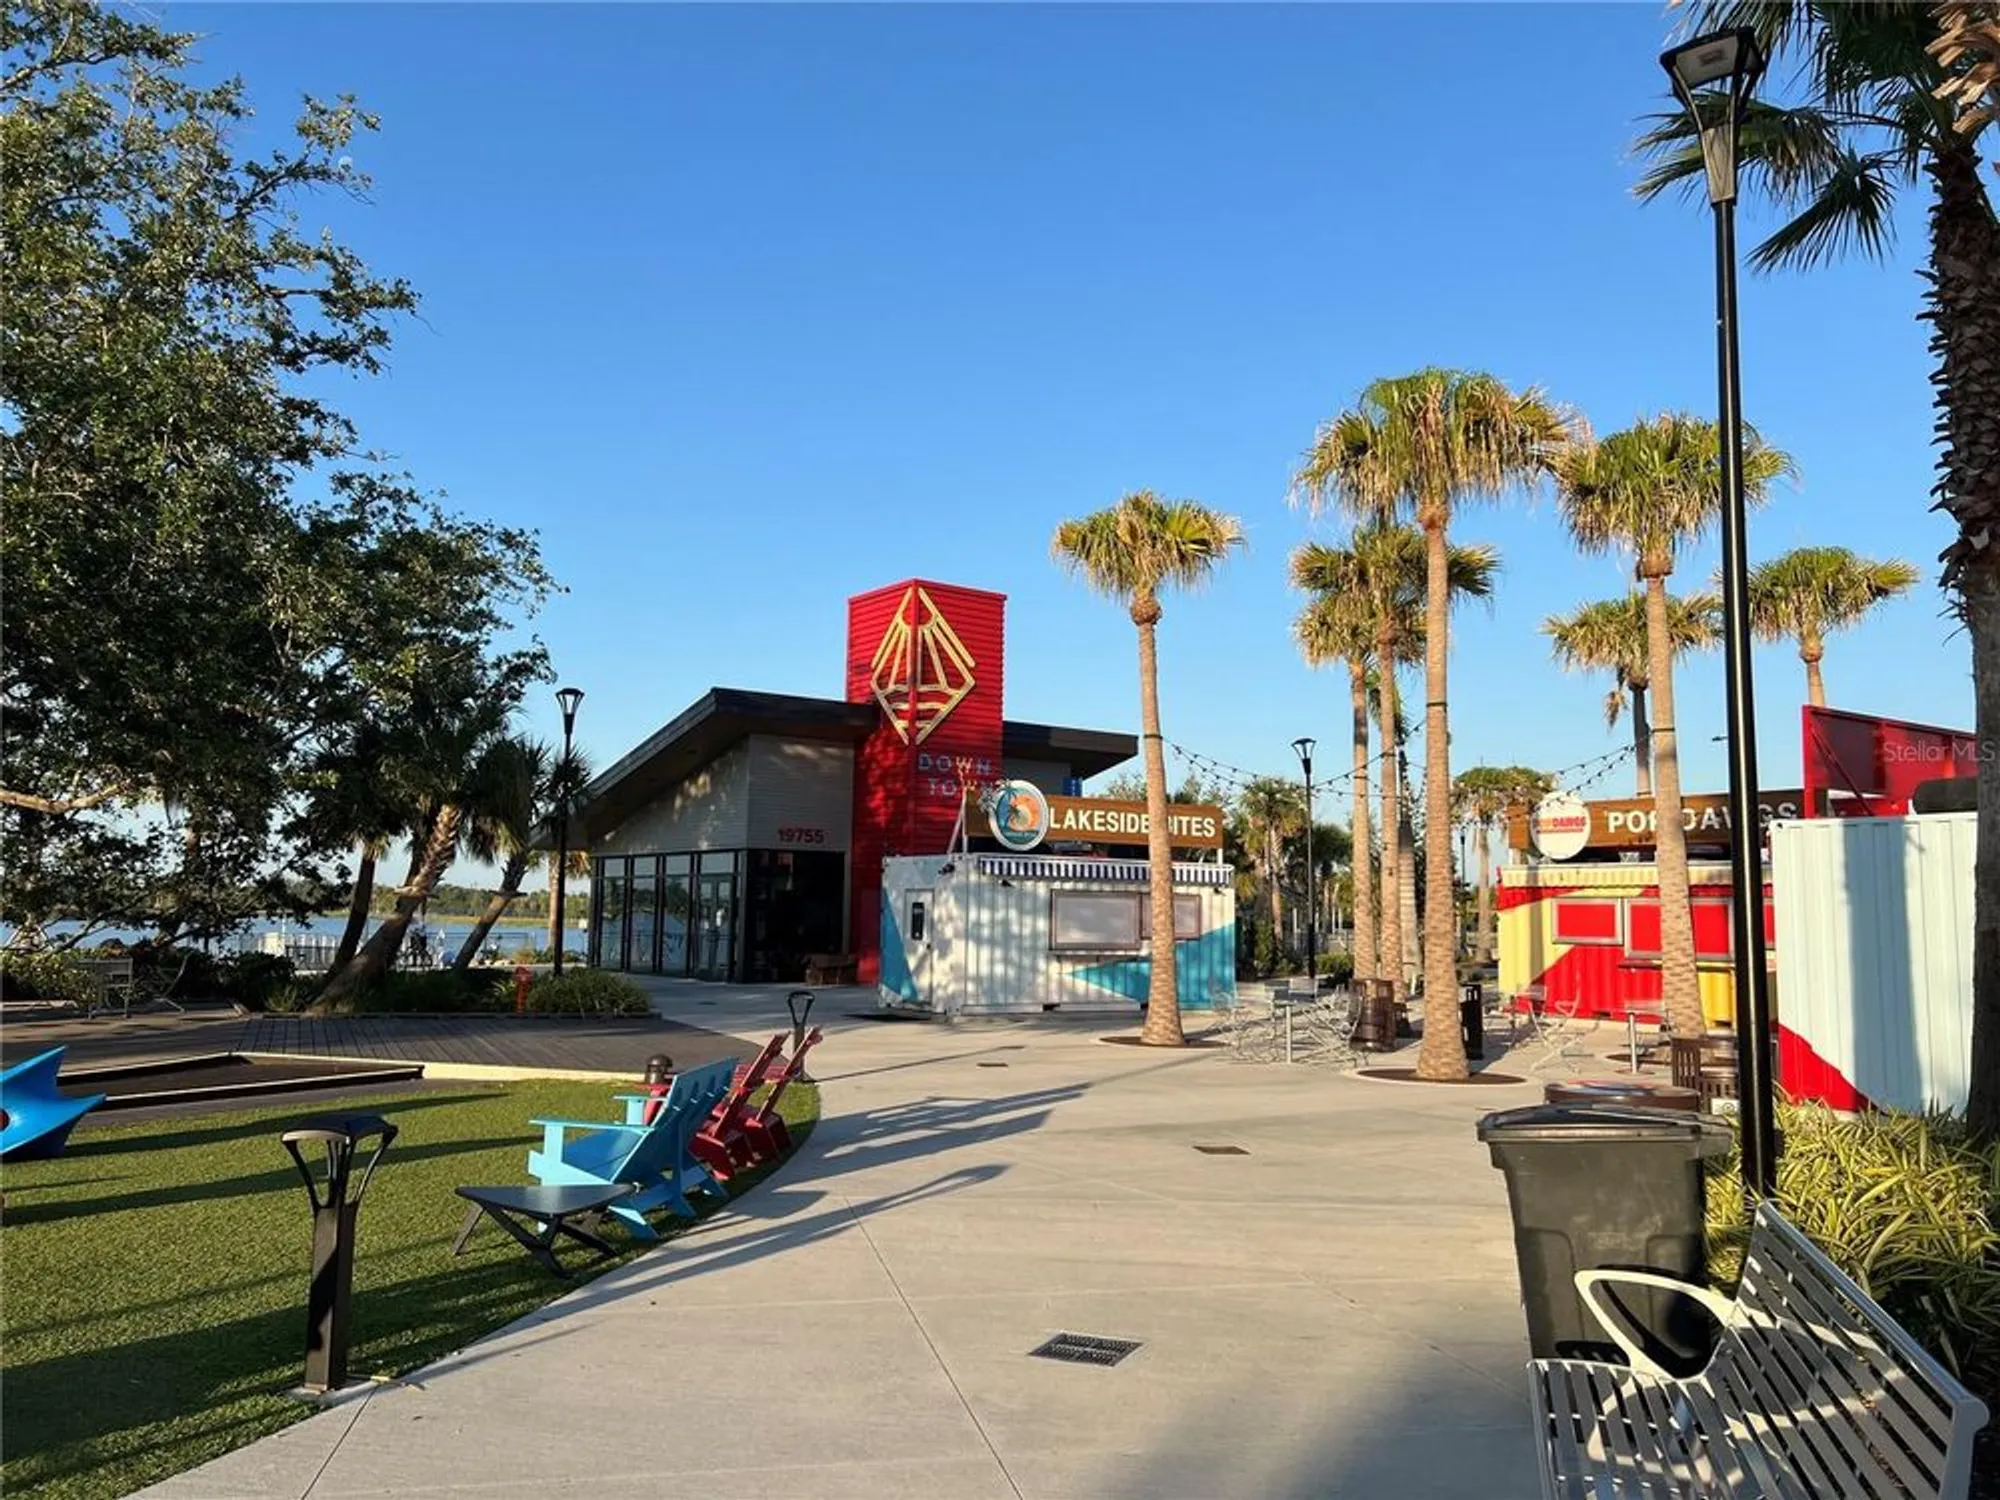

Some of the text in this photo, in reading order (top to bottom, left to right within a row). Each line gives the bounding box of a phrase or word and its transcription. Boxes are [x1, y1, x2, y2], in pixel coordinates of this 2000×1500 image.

[918, 753, 992, 776] DOWN
[1050, 807, 1150, 834] LAKESIDE
[777, 827, 825, 844] 19755
